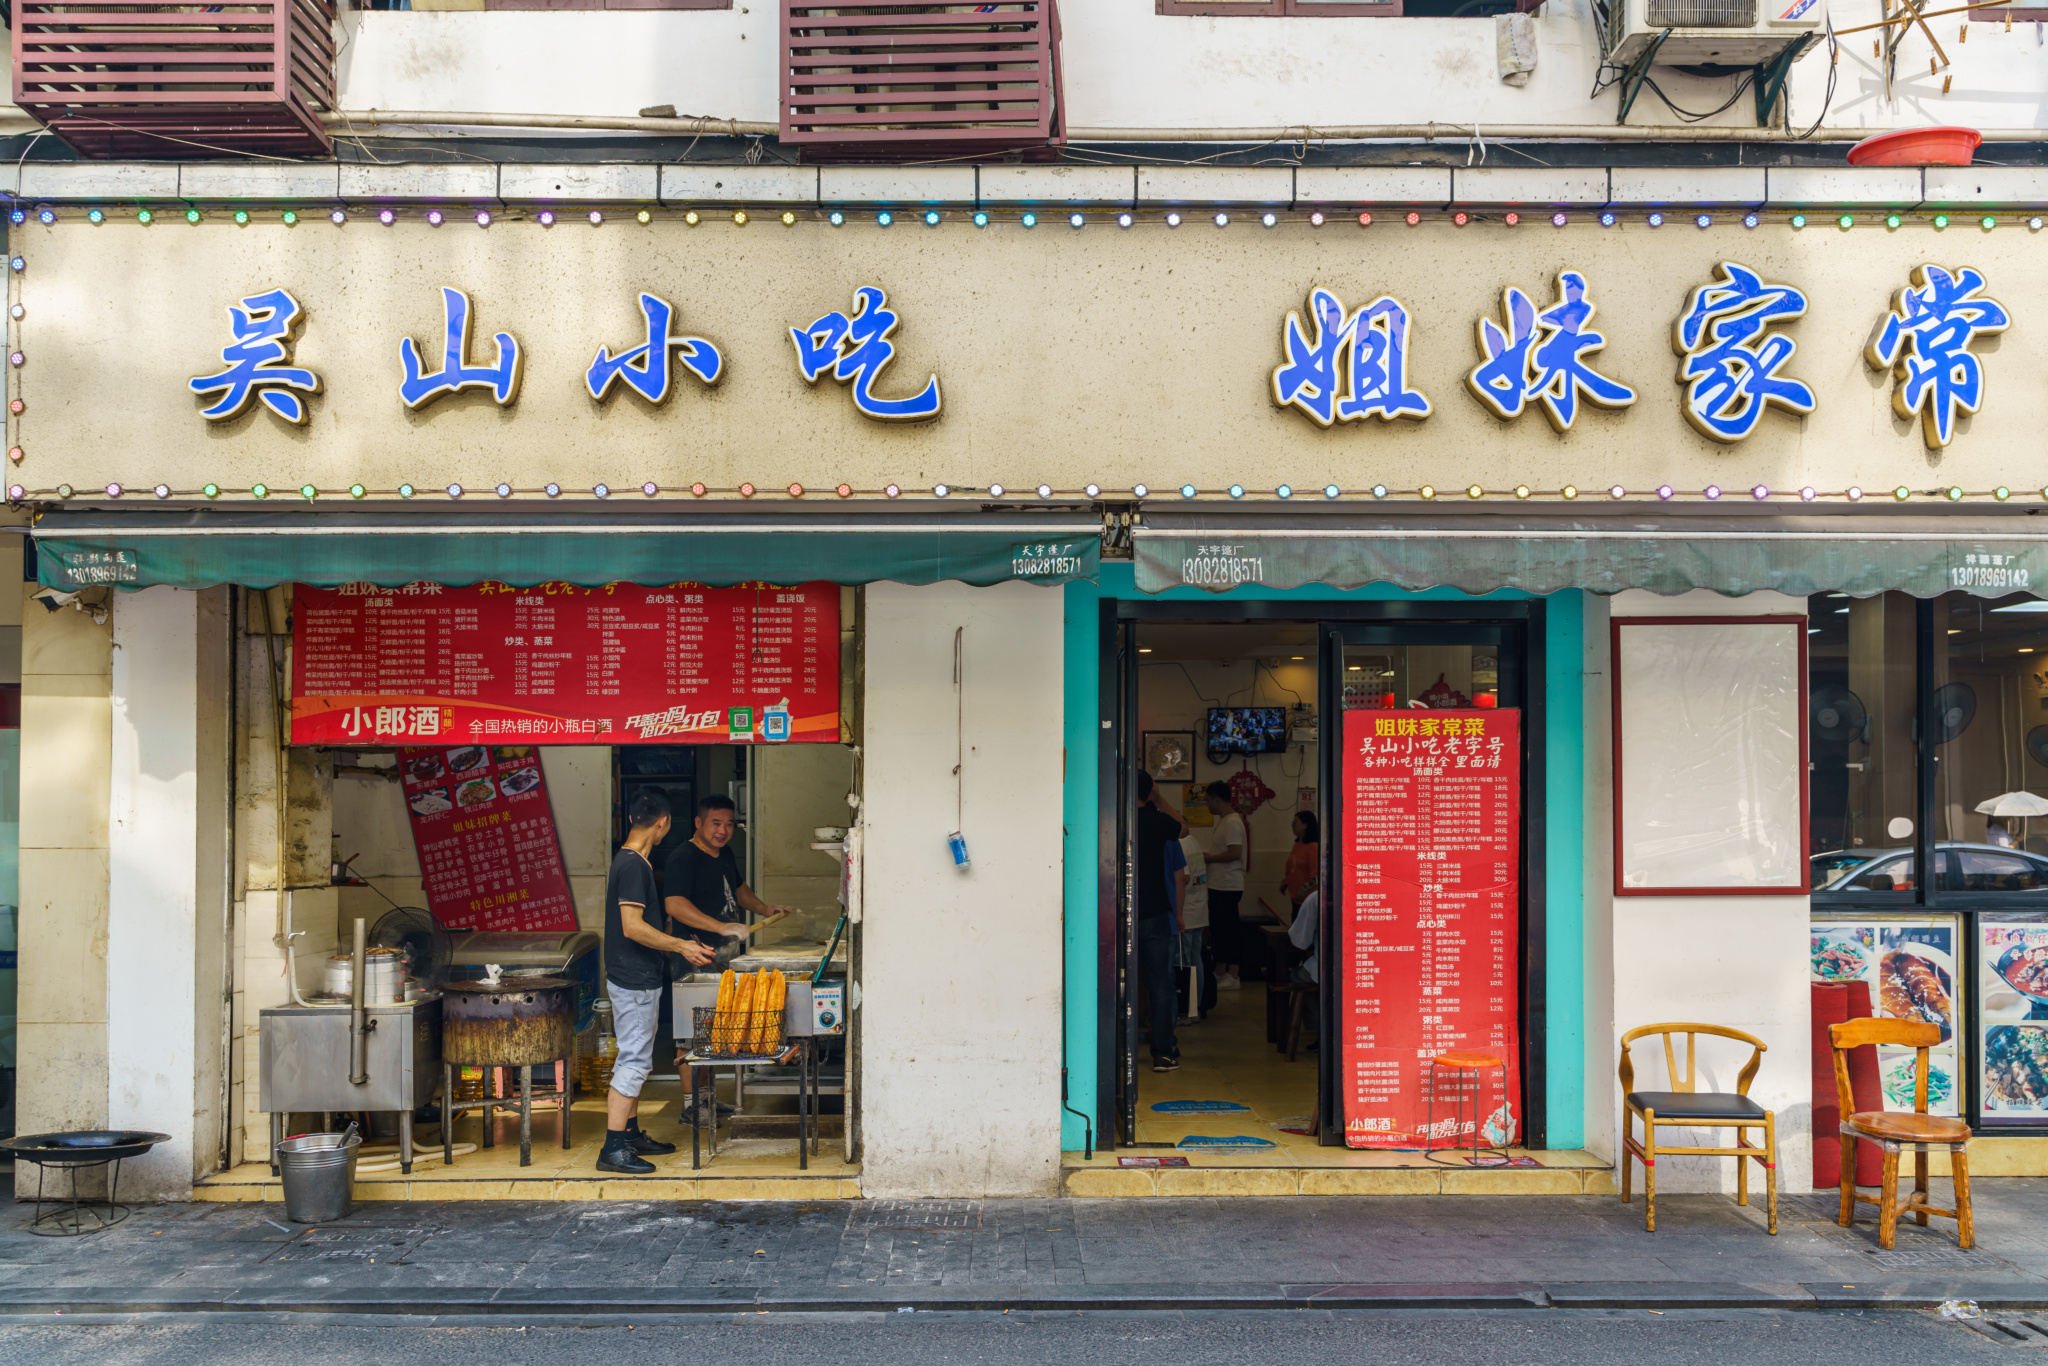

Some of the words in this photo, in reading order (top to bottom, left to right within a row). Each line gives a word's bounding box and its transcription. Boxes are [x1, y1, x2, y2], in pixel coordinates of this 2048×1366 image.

[188, 285, 943, 424] 吴山小吃
[1270, 268, 2012, 448] 姐妹家常
[1012, 557, 1081, 575] 13082818571
[1182, 557, 1263, 583] 13082818571
[67, 564, 136, 583] 13018969142
[1952, 567, 2029, 587] 13018969142
[365, 598, 393, 607] 汤面类
[515, 596, 544, 605] 米线类
[646, 594, 704, 604] 点心类、粥类
[776, 594, 805, 603] 盖浇饭
[505, 636, 553, 646] 炒类、蒸菜
[341, 706, 439, 736] 小郎酒
[625, 705, 687, 730] 开盖扫码
[469, 718, 613, 734] 全国热销的小瓶白酒
[1375, 718, 1485, 736] 姐妹家常菜
[1359, 736, 1504, 755] 吴山小吃老字号
[1363, 756, 1450, 768] 各种小吃样样全
[1454, 755, 1502, 768] 里面请
[1413, 768, 1443, 776] 汤面类
[453, 811, 512, 832] 姐妹招牌菜
[1417, 852, 1447, 860] 米线类
[1423, 884, 1443, 892] 炒类
[470, 889, 530, 912] 特色川湘菜
[1416, 920, 1446, 928] 点心类
[1422, 987, 1442, 996] 蒸菜
[1422, 1016, 1443, 1024] 粥类
[1351, 1118, 1391, 1131] 小郎酒
